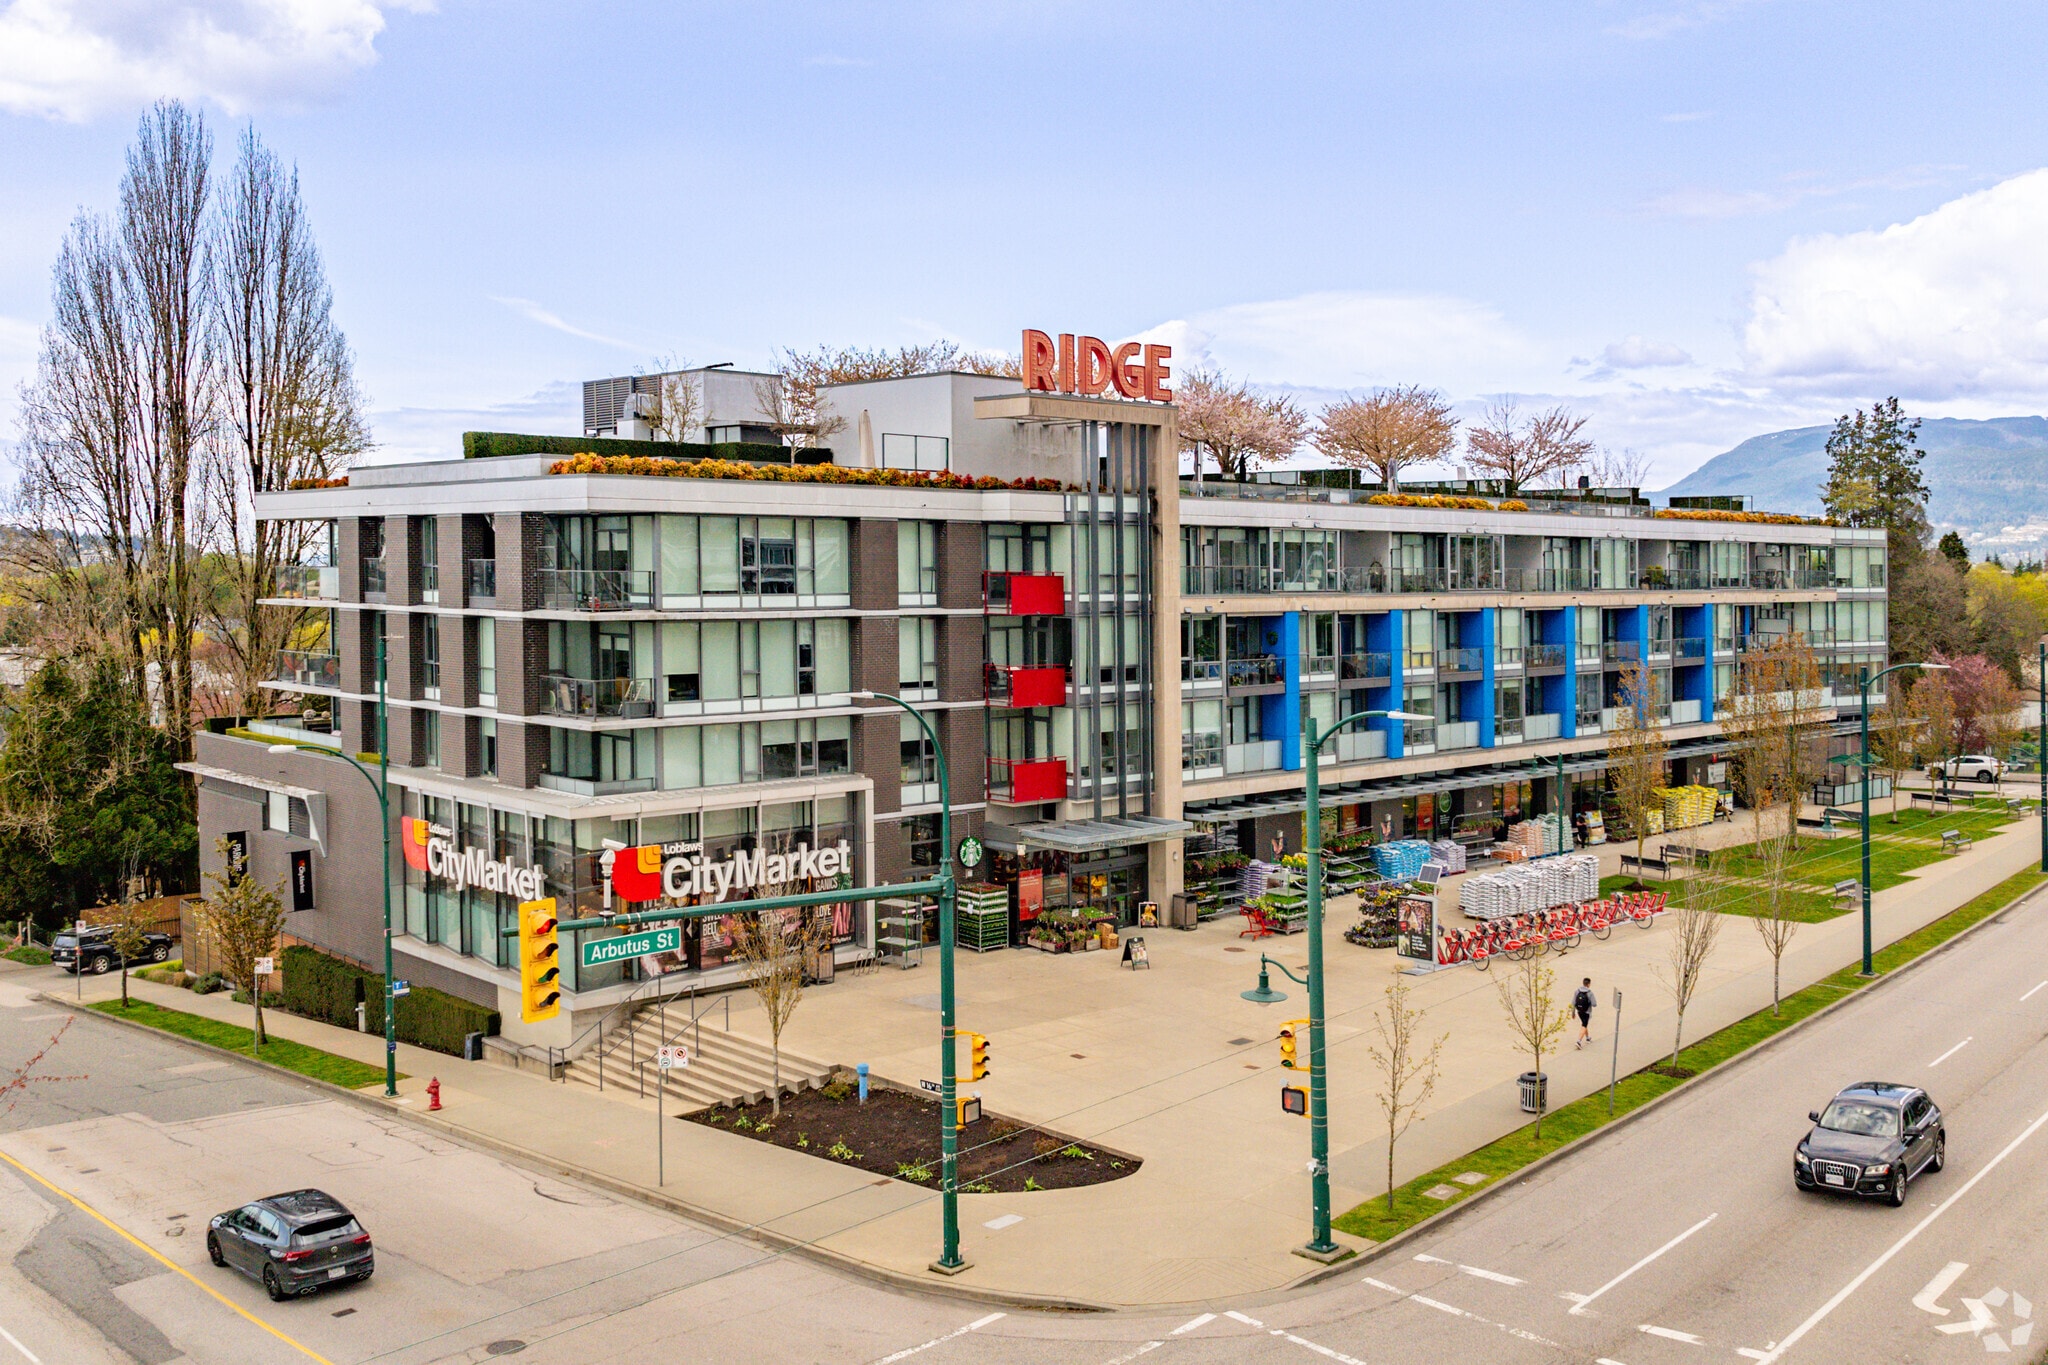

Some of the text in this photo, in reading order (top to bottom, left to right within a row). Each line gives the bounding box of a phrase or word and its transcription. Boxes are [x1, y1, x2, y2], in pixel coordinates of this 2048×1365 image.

[1022, 329, 1172, 401] RIDGE
[427, 837, 547, 901] CityMarket
[663, 839, 850, 902] CityMarket
[664, 842, 704, 855] Loblaws
[591, 932, 674, 961] Arbutus St
